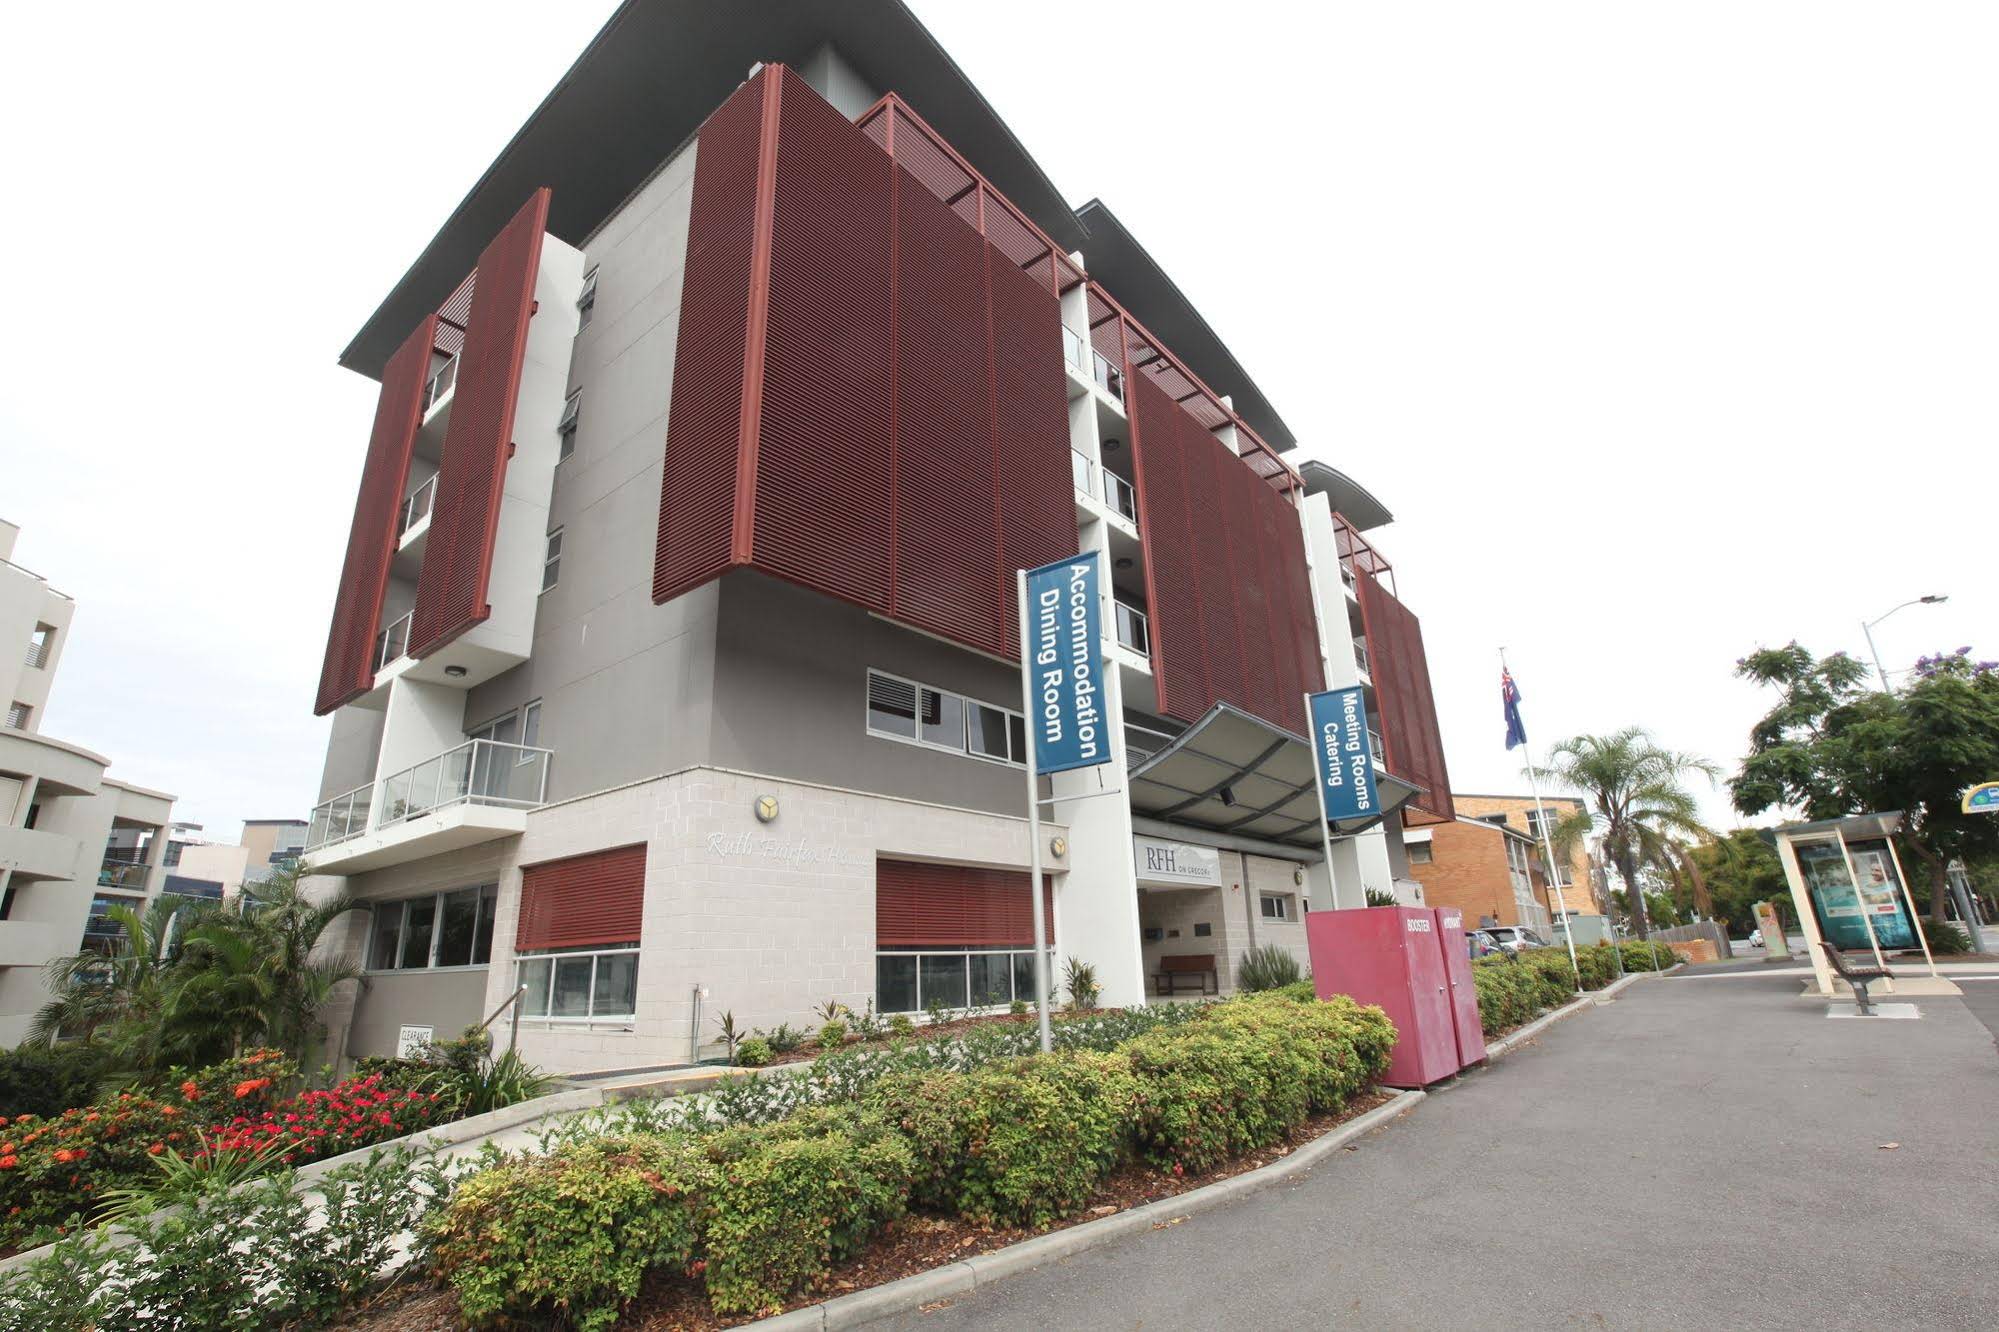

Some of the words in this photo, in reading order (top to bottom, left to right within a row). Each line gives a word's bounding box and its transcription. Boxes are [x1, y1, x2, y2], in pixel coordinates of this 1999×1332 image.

[1037, 588, 1060, 665] Dining
[1070, 564, 1099, 759] Accommodation
[1043, 668, 1063, 743] Room
[1342, 692, 1362, 752] Meeting
[1323, 722, 1343, 787] Catering
[1351, 754, 1370, 810] Rooms
[705, 831, 753, 857] Ruth
[1146, 846, 1177, 872] RFH
[1407, 918, 1431, 932] BOOSTER
[402, 1029, 430, 1041] CLEARANCE
